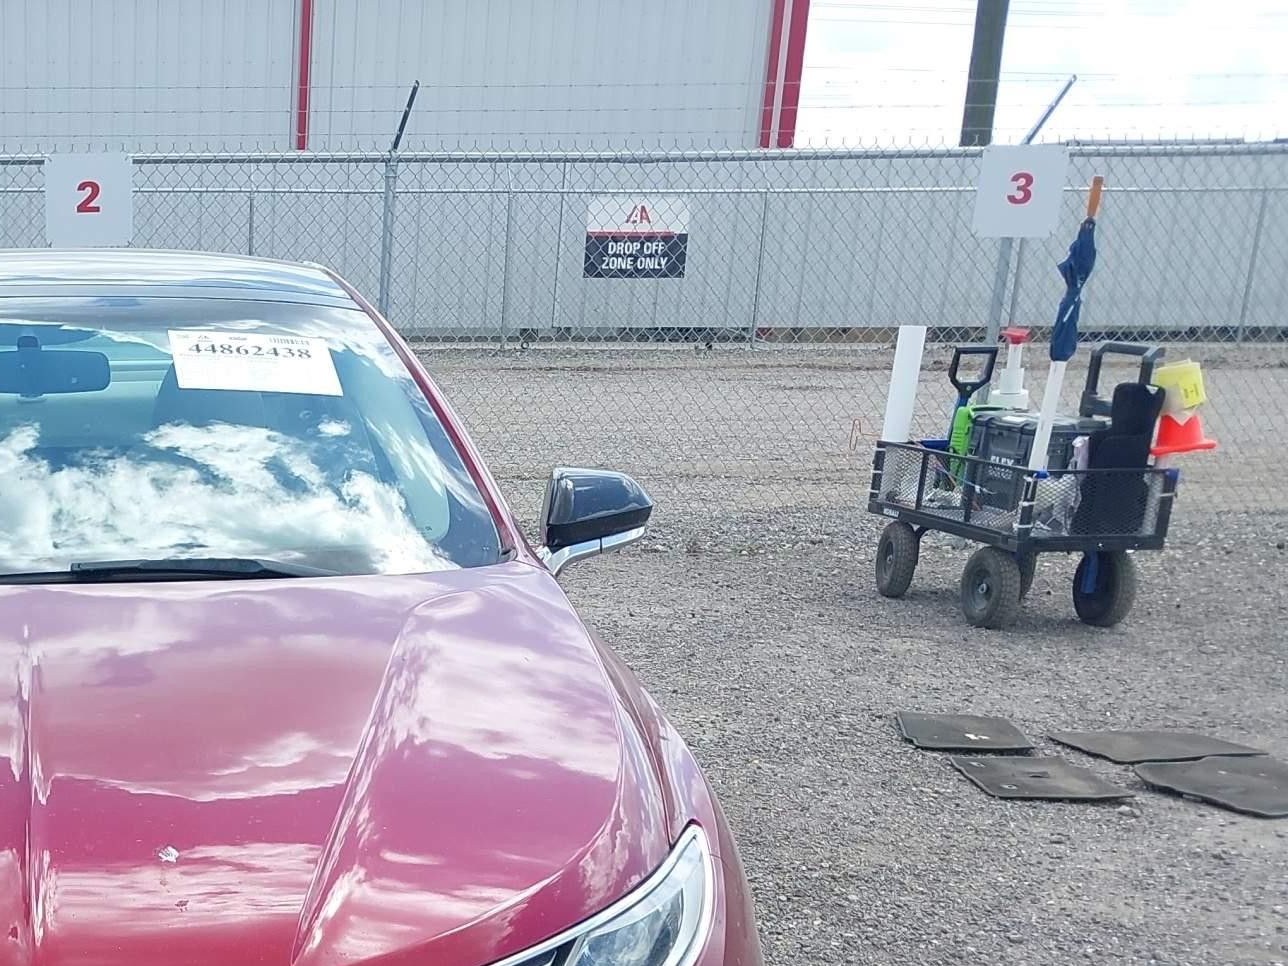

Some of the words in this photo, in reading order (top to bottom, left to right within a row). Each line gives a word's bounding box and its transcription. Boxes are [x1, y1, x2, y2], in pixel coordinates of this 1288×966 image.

[76, 181, 101, 213] 2
[1007, 172, 1034, 205] 3
[608, 242, 641, 255] DROP
[643, 242, 666, 255] OFF
[601, 256, 634, 270] ZONE
[636, 256, 669, 270] ONLY
[187, 342, 313, 360] 44862438
